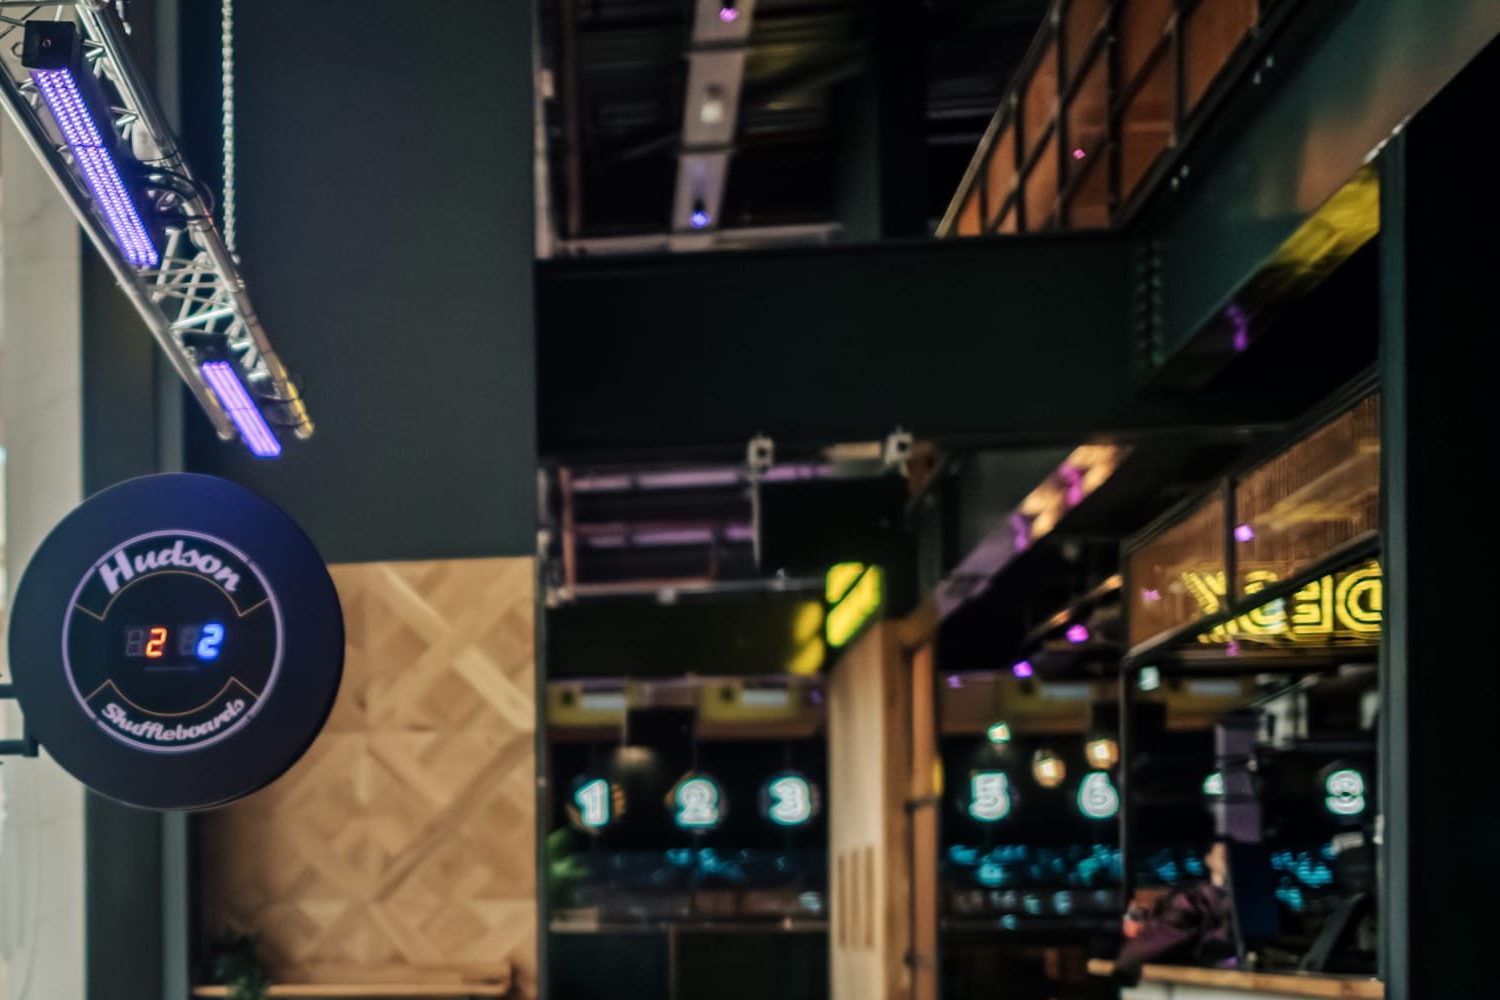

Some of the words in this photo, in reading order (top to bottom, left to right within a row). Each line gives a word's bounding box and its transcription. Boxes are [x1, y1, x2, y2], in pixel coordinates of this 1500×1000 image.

[99, 540, 241, 595] Hudson
[145, 627, 168, 658] 2
[196, 622, 225, 661] 2
[101, 698, 245, 742] Shuffleboards
[574, 778, 610, 827] 1
[674, 776, 719, 828] 2
[768, 776, 812, 826] 3
[968, 771, 1011, 822] 5
[1076, 770, 1120, 819] 6
